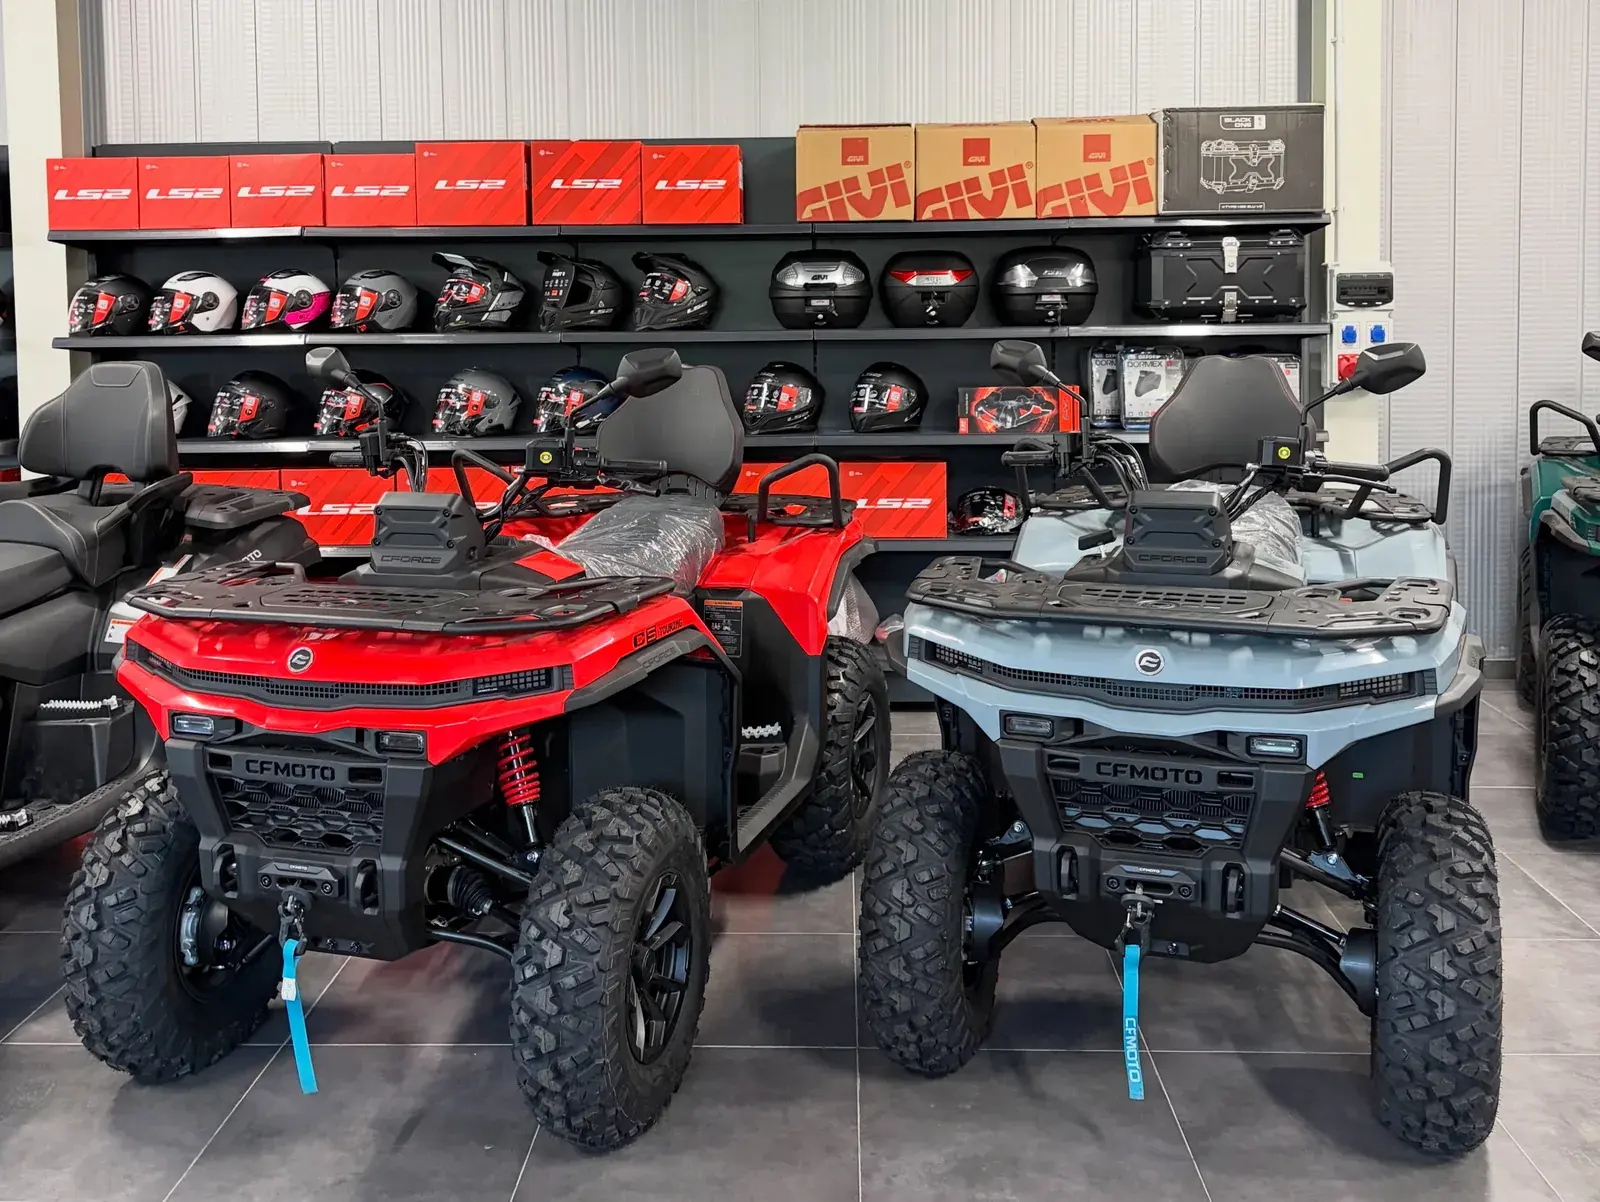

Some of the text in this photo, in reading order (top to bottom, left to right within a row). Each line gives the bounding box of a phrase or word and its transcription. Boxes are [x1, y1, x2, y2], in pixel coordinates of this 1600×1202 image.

[846, 155, 864, 163] GIVI
[967, 155, 986, 163] GIVI
[1087, 151, 1107, 160] GIVI
[435, 179, 507, 190] LS2
[550, 178, 623, 189] LS2
[655, 179, 727, 190] LS2
[1036, 159, 1154, 218] GIVI
[54, 188, 132, 200] LS2
[145, 187, 224, 200] LS2
[237, 185, 316, 198] LS2
[331, 185, 410, 197] LS2
[797, 163, 911, 221] GIVI
[916, 163, 1033, 220] GIVI
[296, 503, 376, 516] LS2
[856, 498, 932, 509] LS2
[380, 554, 442, 565] CFORCE
[1138, 554, 1208, 564] CFORCE
[245, 759, 336, 782] CFMOTO
[1095, 761, 1203, 786] CFMOTO
[1125, 1017, 1141, 1083] CFMOTO
